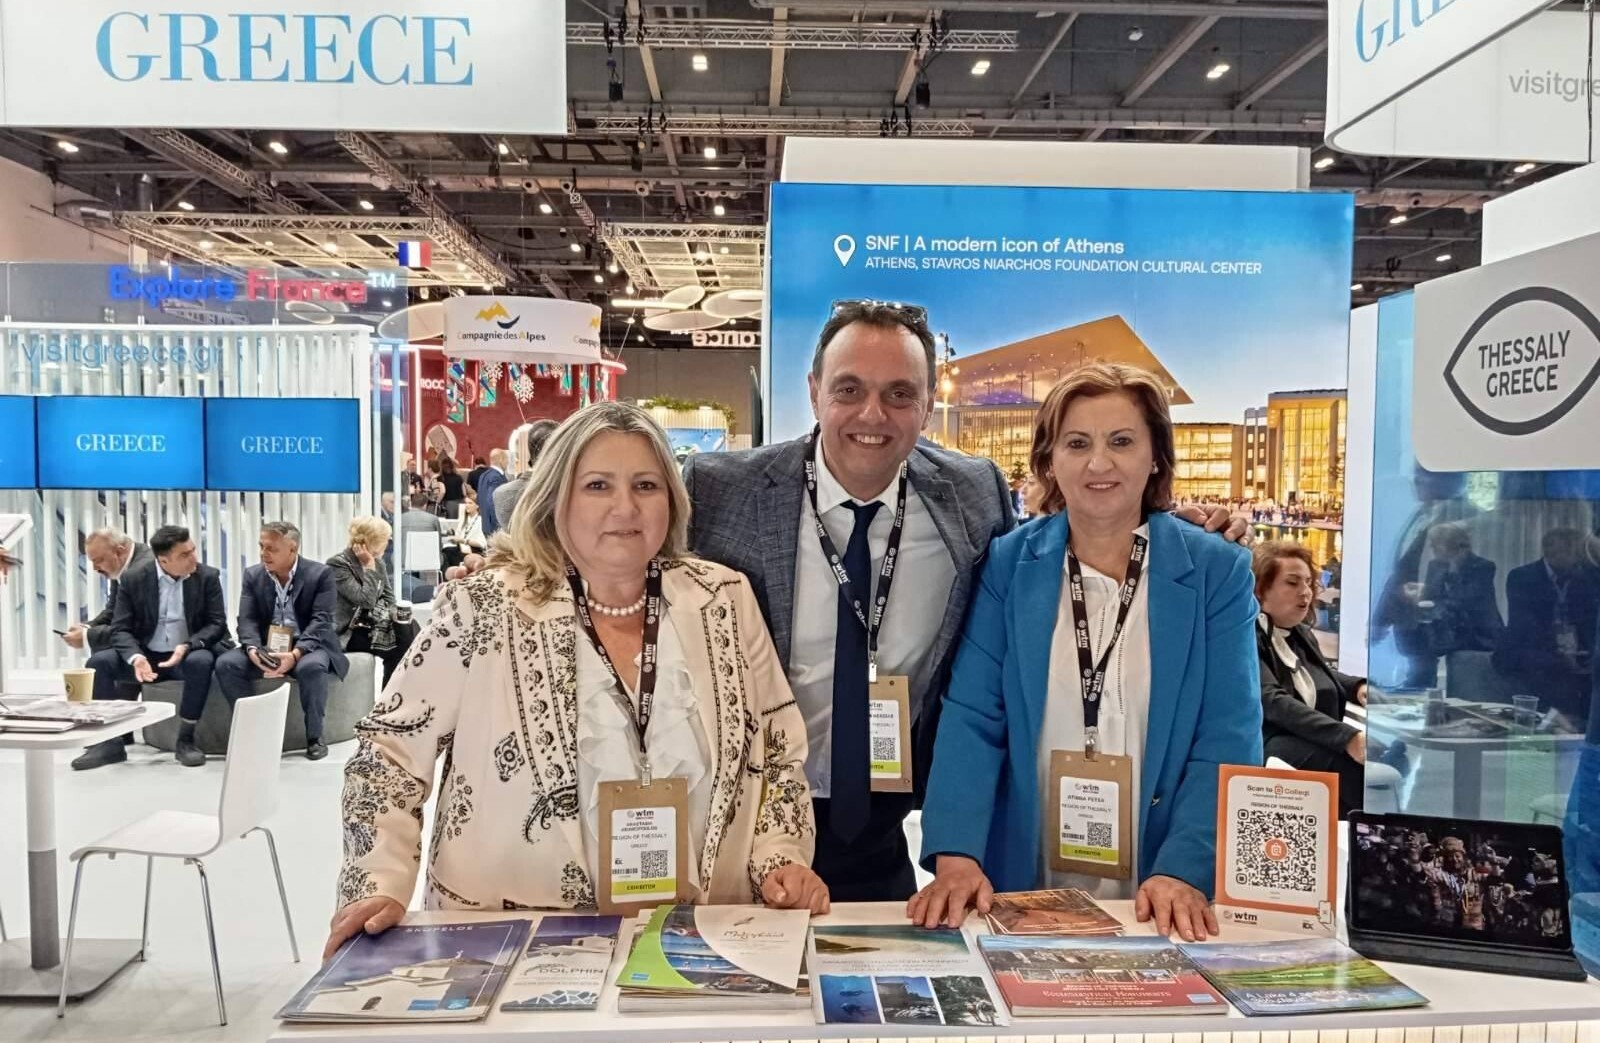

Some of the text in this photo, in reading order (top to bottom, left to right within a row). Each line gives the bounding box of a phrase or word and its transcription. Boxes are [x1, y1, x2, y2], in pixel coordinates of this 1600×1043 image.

[95, 11, 473, 86] GREECE
[865, 235, 900, 250] SNF
[913, 236, 926, 250] A
[931, 237, 997, 252] modern
[1002, 238, 1038, 252] icon
[1042, 238, 1060, 252] of
[1064, 238, 1124, 254] Athens
[865, 257, 1262, 274] ATHENS, STAVROS NIARCHOS FOUNDATION CULTURAL CENTER
[108, 267, 237, 309] Explore
[246, 268, 367, 303] France
[457, 330, 546, 343] Compagnie des Alpes
[21, 336, 223, 372] visitgreece.gr
[1478, 329, 1571, 370] THESSALY
[1486, 364, 1559, 398] GREECE
[75, 434, 165, 453] GREECE
[240, 436, 324, 454] GREECE
[836, 563, 848, 582] wtm
[885, 557, 893, 577] wtm
[1075, 583, 1083, 601] wtm
[647, 597, 656, 615] wtm
[874, 605, 882, 626] wtm
[1081, 629, 1089, 648] wtm
[644, 644, 653, 663] wtm
[641, 693, 650, 714] wtm
[1082, 783, 1099, 791] wtm
[1234, 912, 1257, 921] wtm
